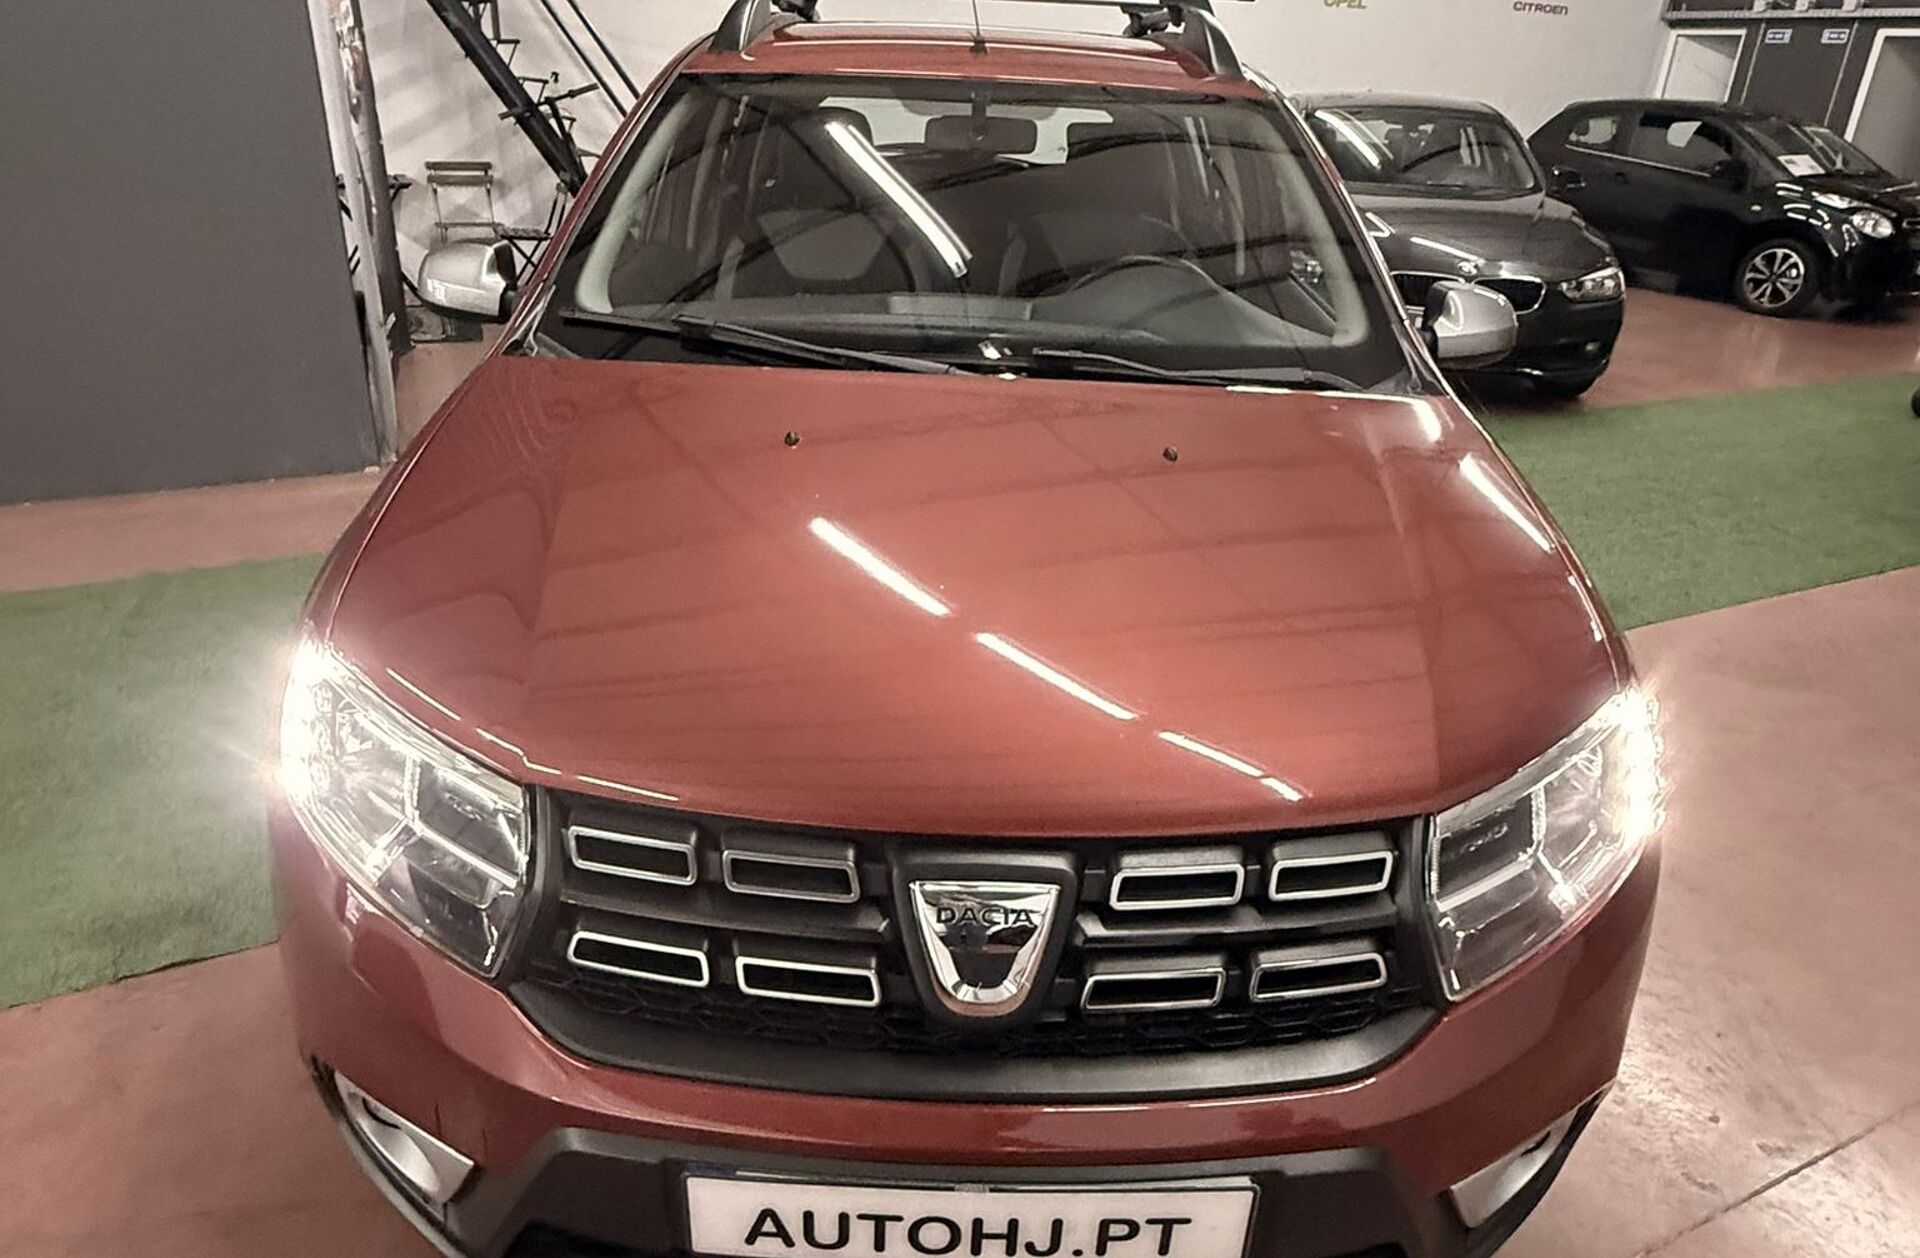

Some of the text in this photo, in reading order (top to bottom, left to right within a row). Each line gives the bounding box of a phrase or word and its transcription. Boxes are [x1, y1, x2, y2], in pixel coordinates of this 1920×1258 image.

[1323, 0, 1367, 9] OPEL
[936, 907, 1034, 926] DACIA
[745, 1208, 1192, 1257] AUTOHJ.PT
